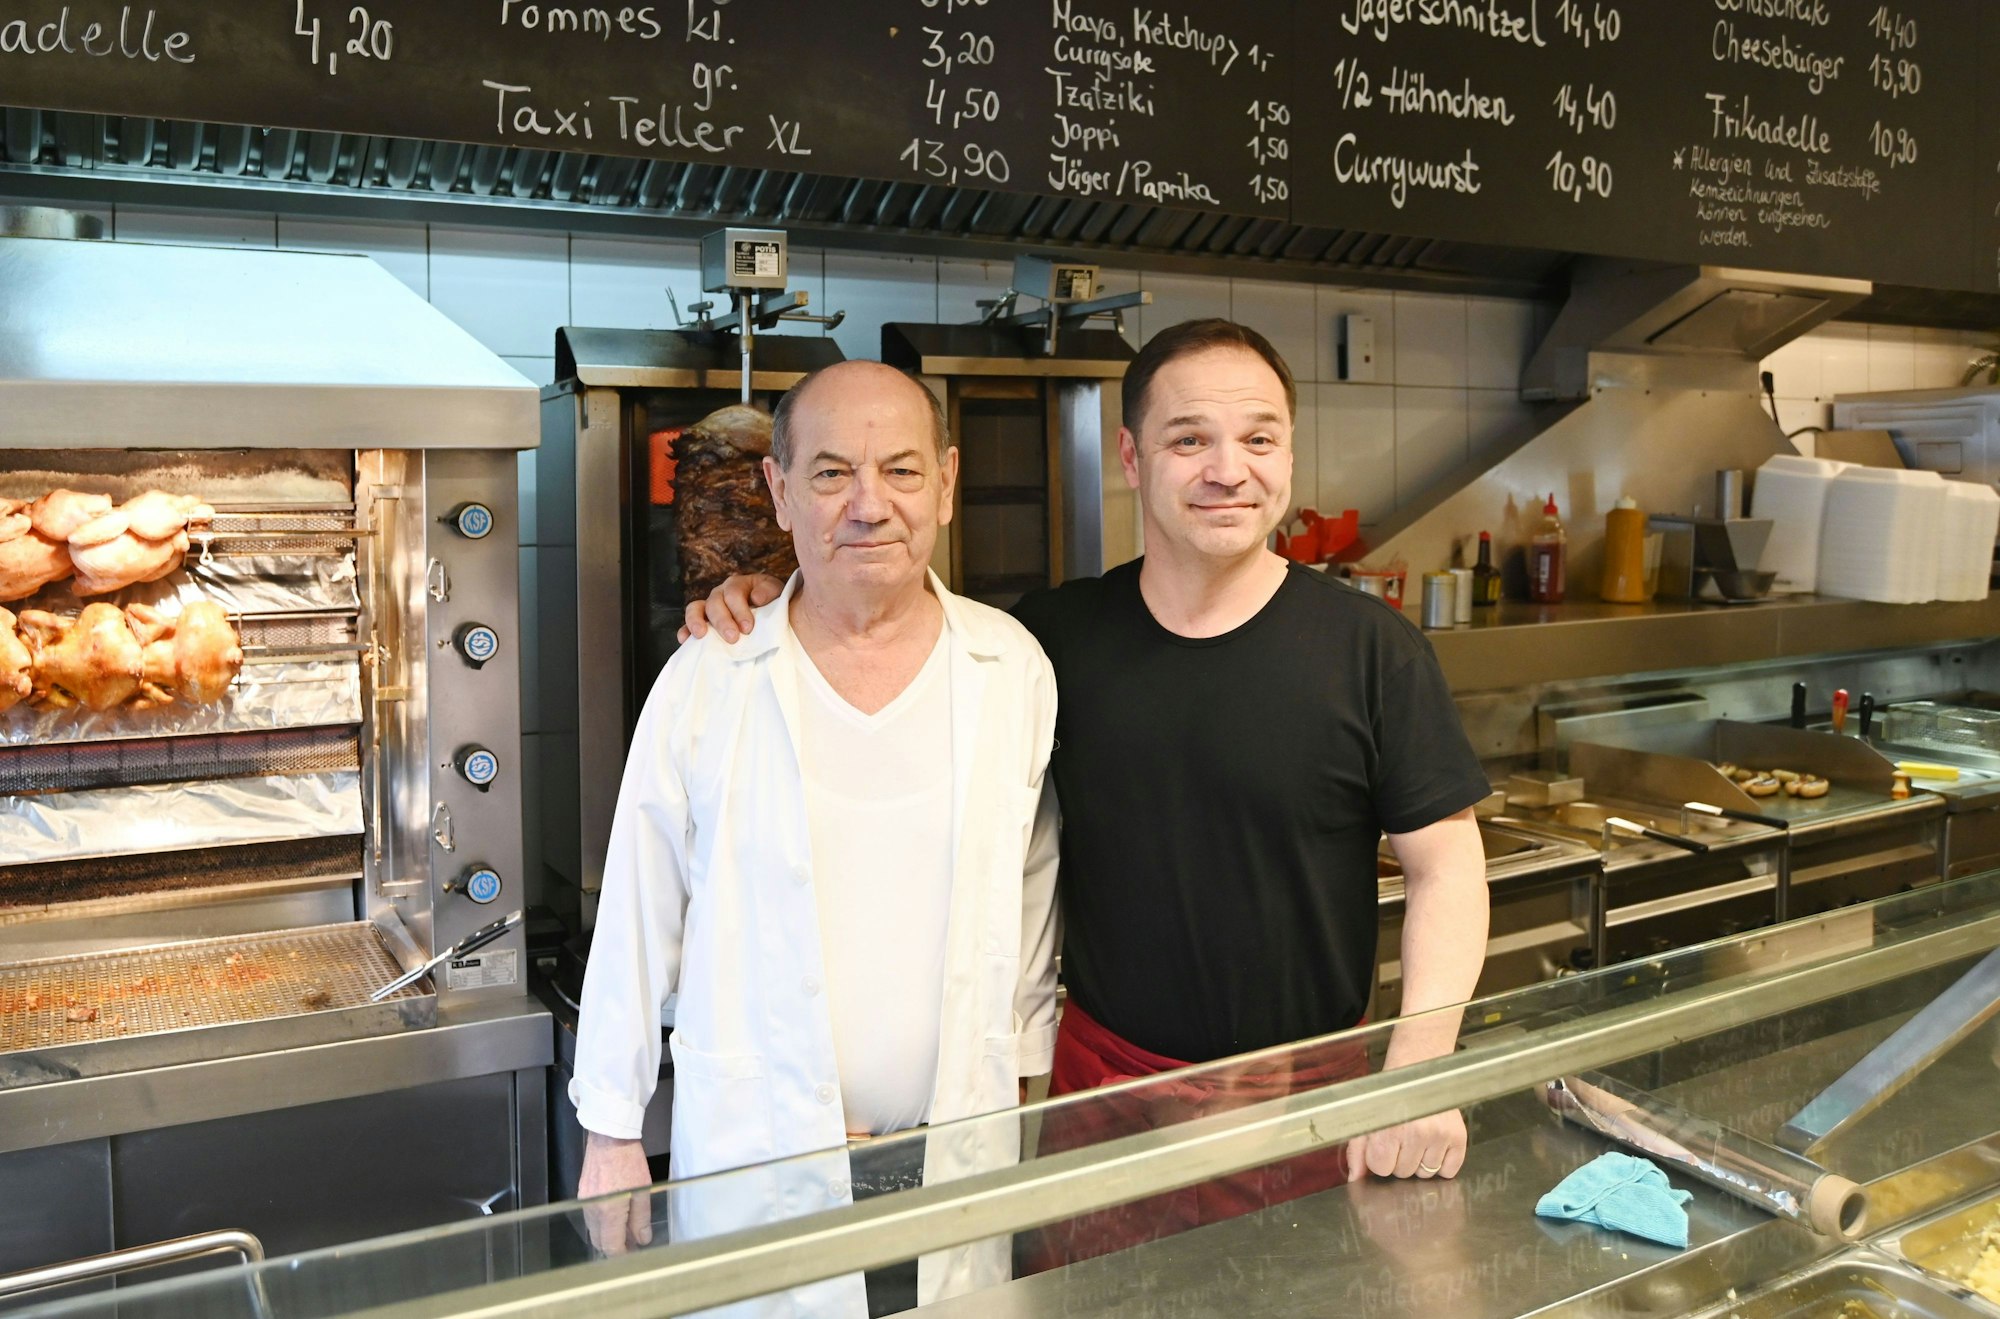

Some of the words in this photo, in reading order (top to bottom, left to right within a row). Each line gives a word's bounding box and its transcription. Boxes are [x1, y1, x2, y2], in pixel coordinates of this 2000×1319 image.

[0, 5, 195, 63] adelle
[294, 0, 394, 75] 4,20
[921, 26, 995, 75] 3,20
[1052, 0, 1125, 48] Mayo,
[1133, 7, 1226, 66] Ketchup
[1555, 0, 1621, 49] 14,40
[1867, 5, 1916, 52] 14,40
[692, 62, 738, 112] gr.
[925, 78, 1000, 129] 4,50
[1044, 67, 1155, 116] Tzatziki
[1247, 100, 1290, 133] 1,50
[1334, 57, 1373, 110] 1/2
[1380, 66, 1516, 126] Hähnchen
[1552, 83, 1617, 135] 14,40
[1868, 53, 1921, 99] 13,90
[482, 79, 593, 140] Taxi
[608, 96, 745, 152] Teller
[765, 114, 812, 155] XL
[900, 137, 1010, 184] 13,90
[1051, 113, 1120, 152] Joppi
[1246, 136, 1289, 166] 1,50
[1704, 92, 1831, 154] Frikadelle
[1868, 120, 1918, 169] 10,90
[1248, 174, 1289, 204] 1,50
[1333, 132, 1482, 209] Currywurst
[1545, 150, 1613, 203] 10,90
